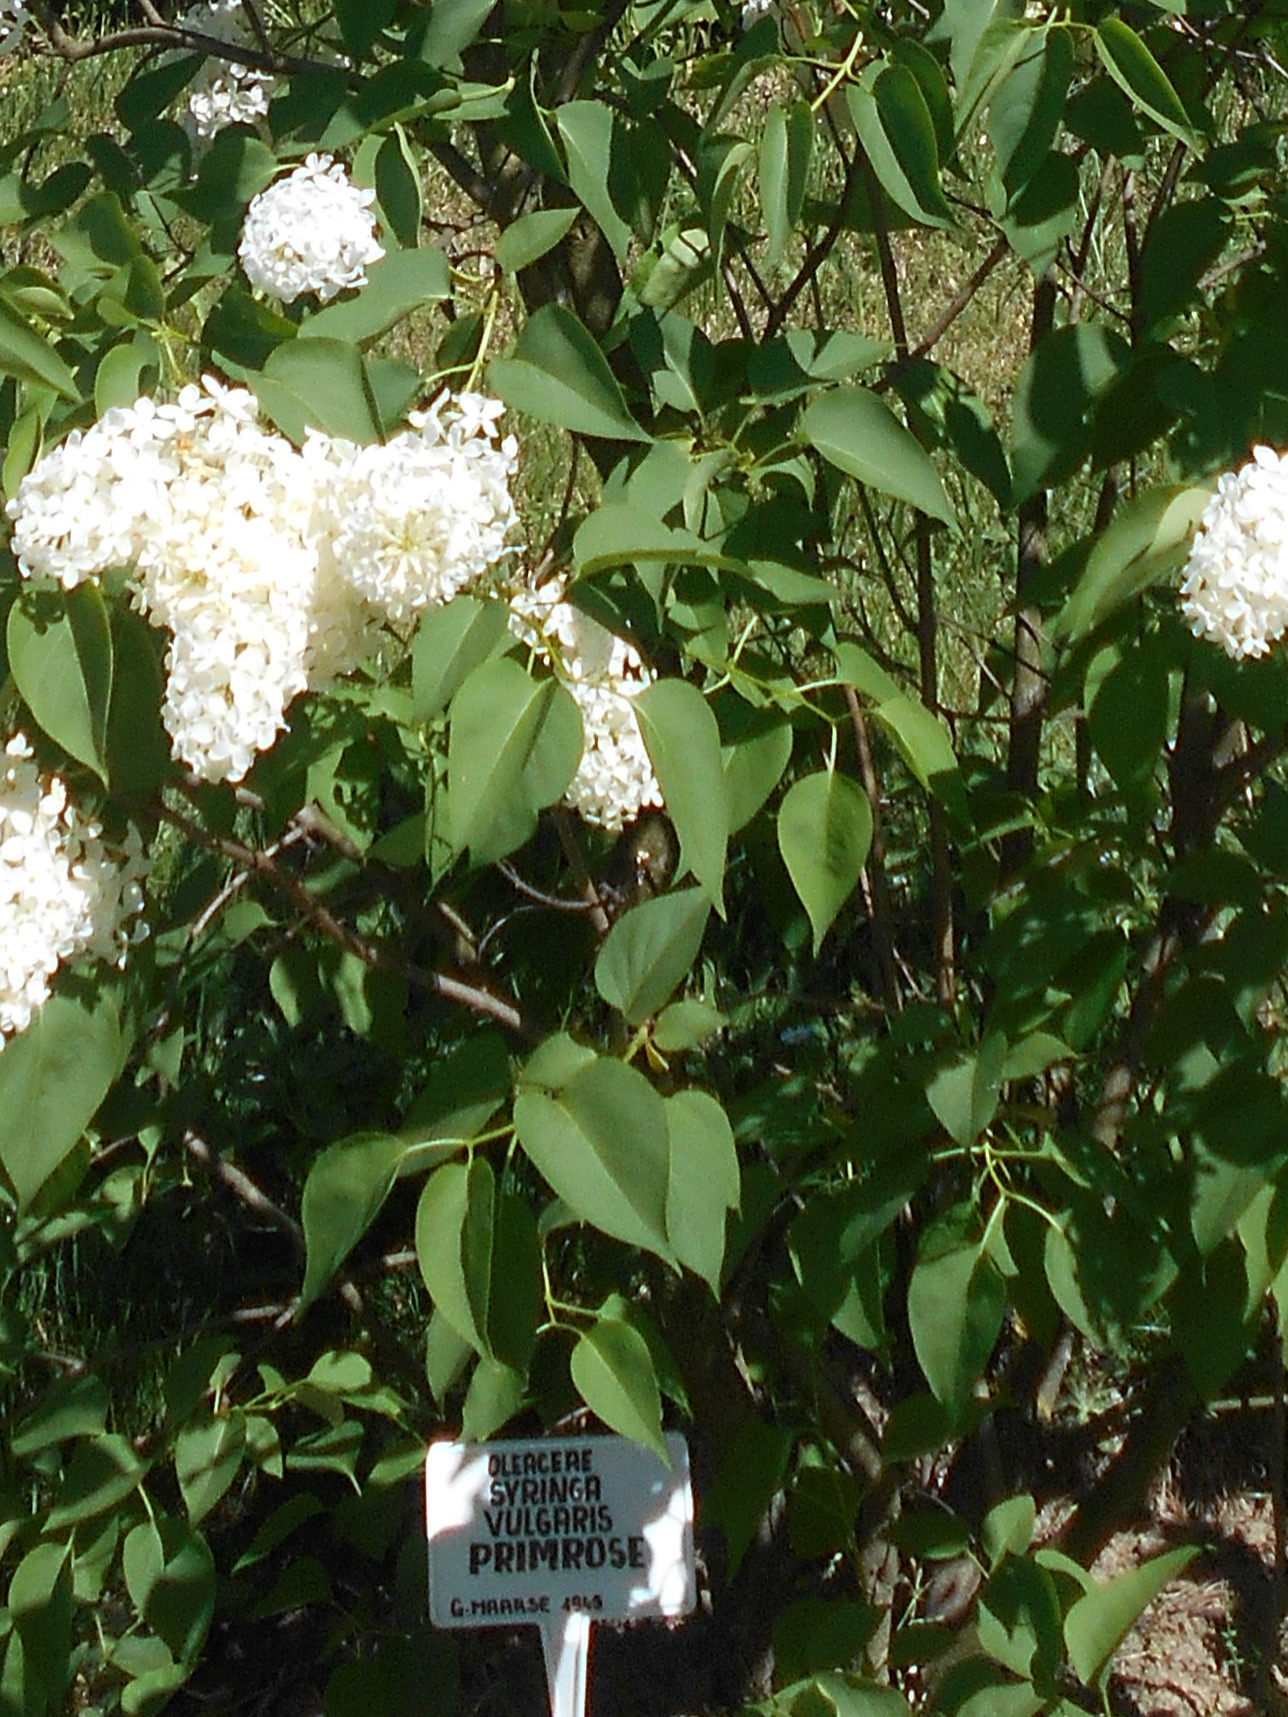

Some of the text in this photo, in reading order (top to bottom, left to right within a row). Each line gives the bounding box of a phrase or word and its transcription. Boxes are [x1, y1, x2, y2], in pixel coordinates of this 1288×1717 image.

[490, 1475, 601, 1506] SYRINGA
[484, 1505, 612, 1537] VULGARIS
[469, 1536, 644, 1574] PRIMROSE
